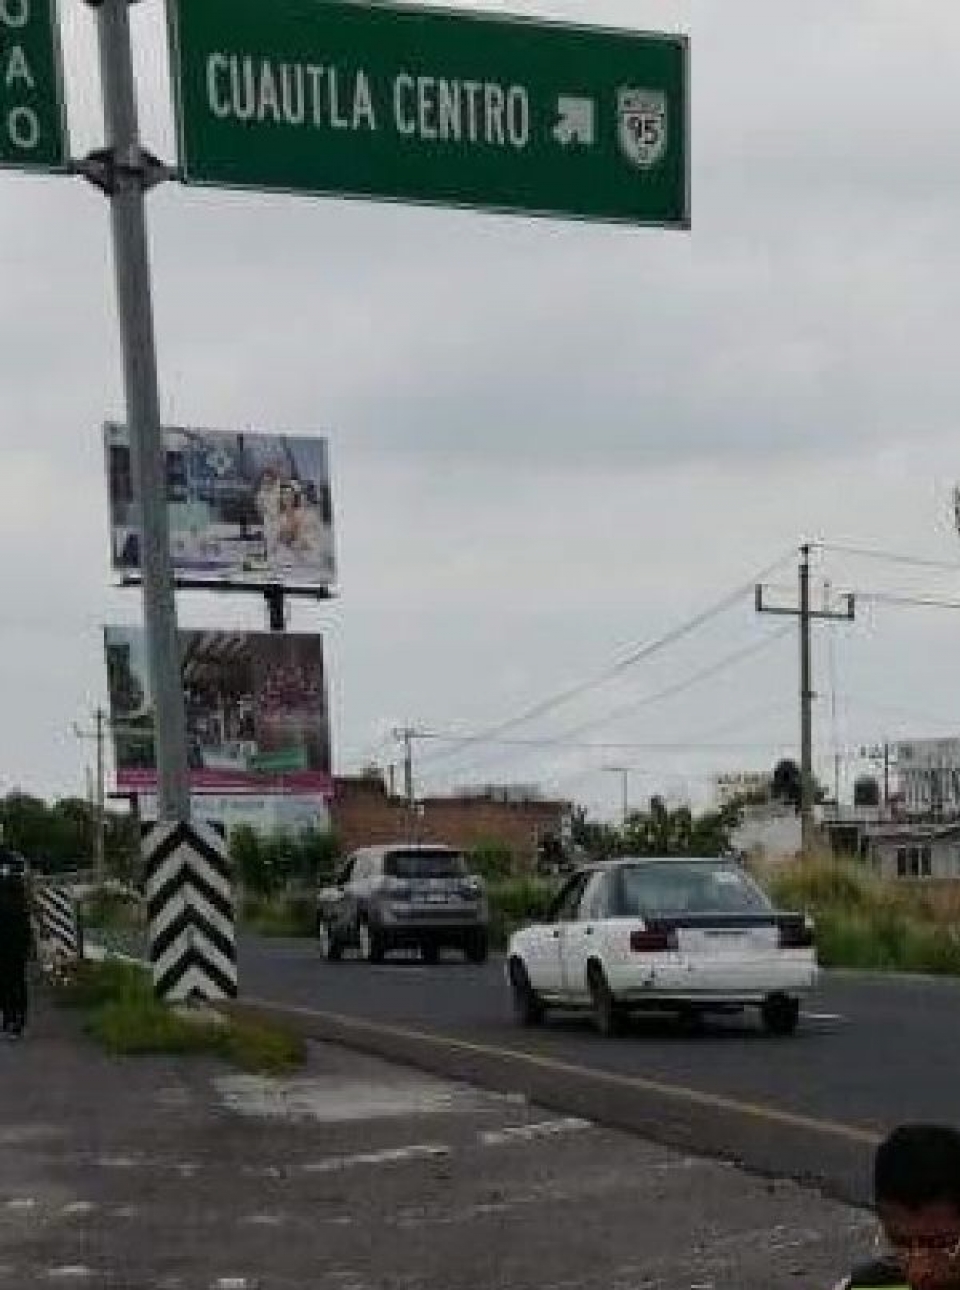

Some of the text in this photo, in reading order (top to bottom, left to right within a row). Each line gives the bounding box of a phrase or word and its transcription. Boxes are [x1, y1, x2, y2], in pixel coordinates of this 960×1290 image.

[206, 52, 529, 147] CUAUTLA CENTRO
[626, 115, 659, 145] 95
